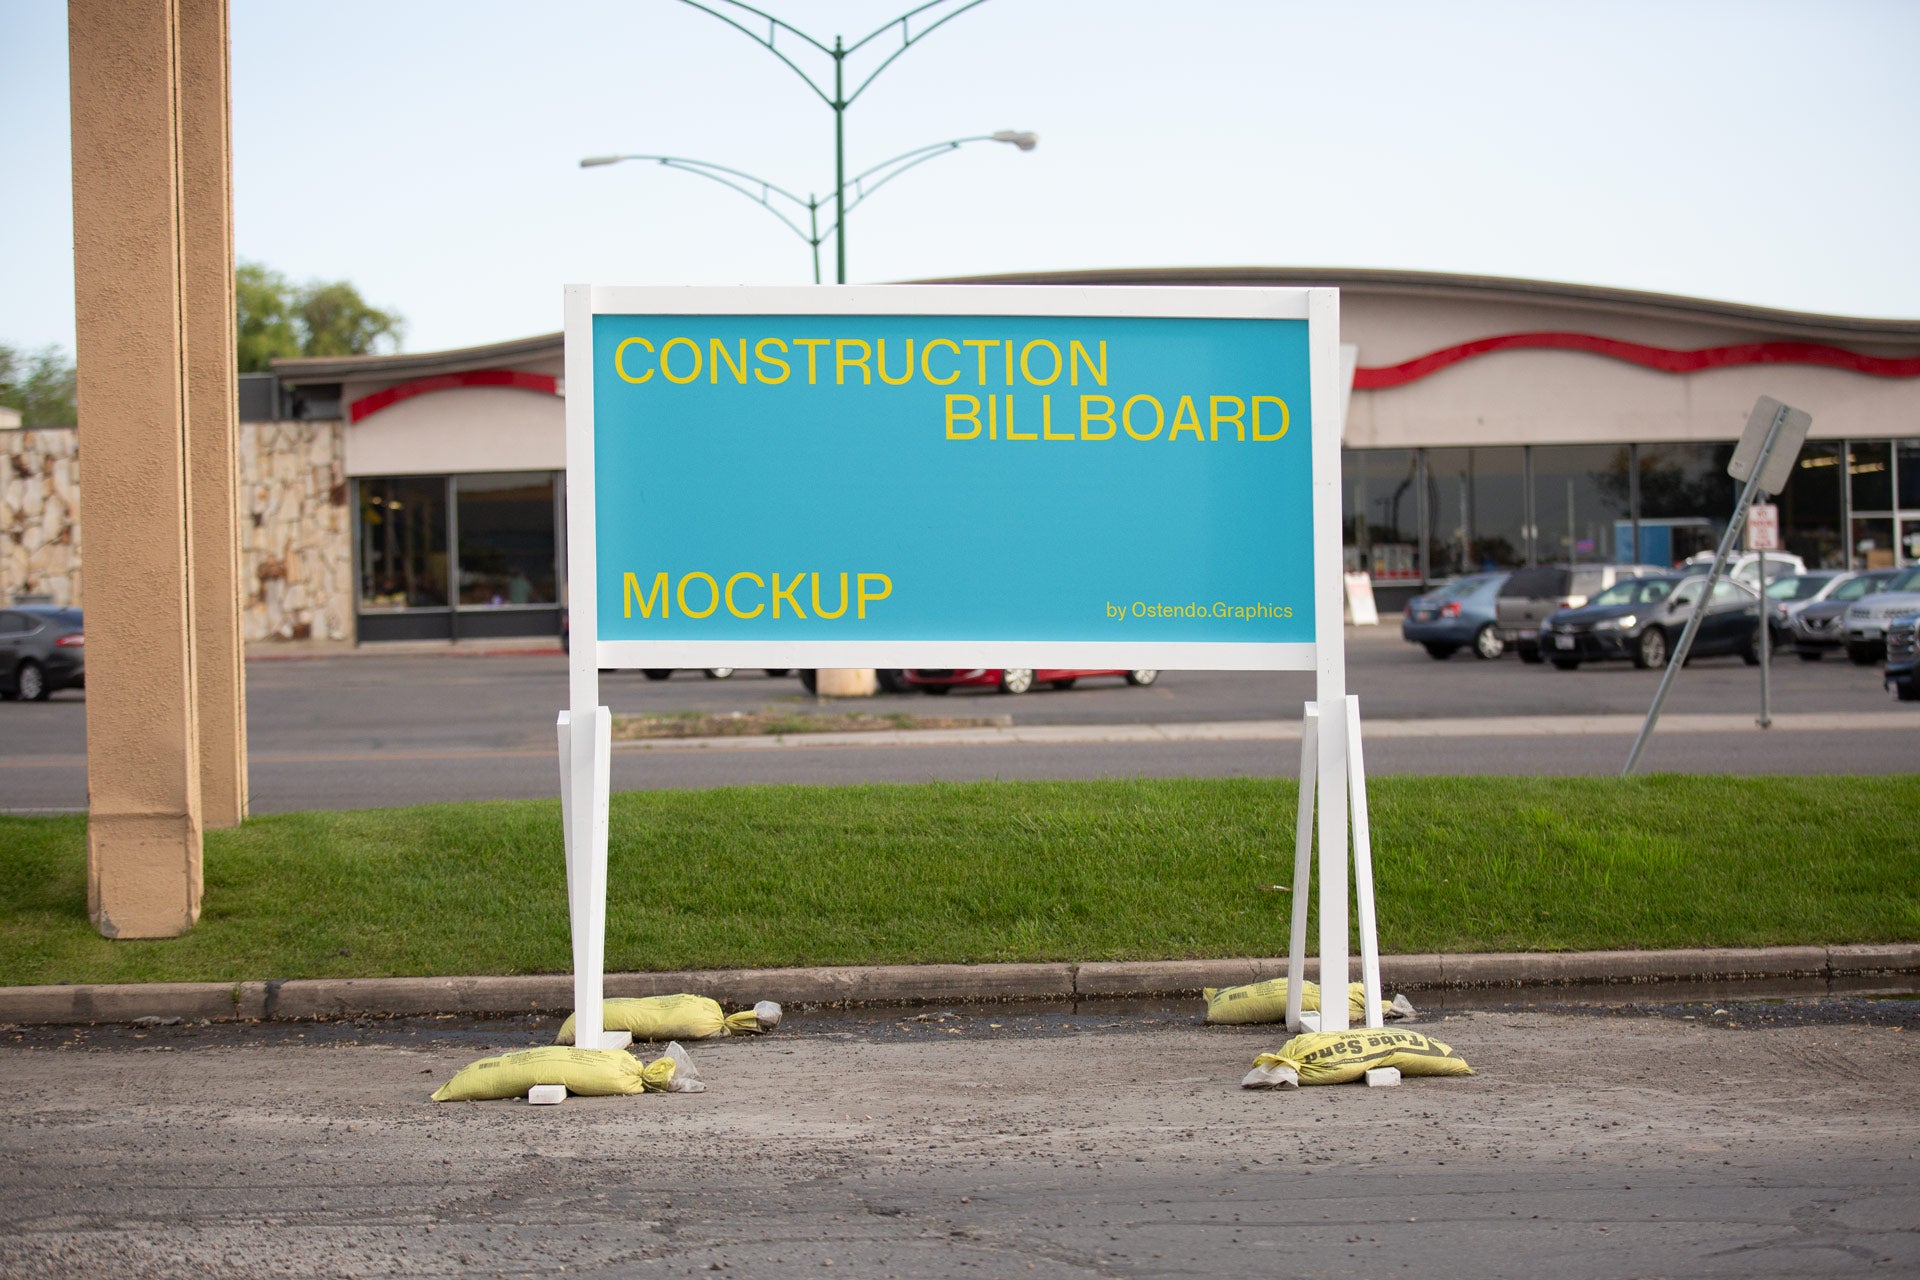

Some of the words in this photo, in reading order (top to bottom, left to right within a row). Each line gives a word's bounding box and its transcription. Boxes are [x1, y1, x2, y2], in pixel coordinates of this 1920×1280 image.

[614, 336, 1108, 387] CONSTRUCTION
[945, 393, 1291, 442] BILLBOARD
[623, 571, 894, 620] MOCKUP
[1106, 602, 1127, 622] by
[1131, 601, 1293, 622] Ostendo.Graphics
[1304, 1040, 1361, 1064] Sand
[1368, 1034, 1424, 1048] Tube
